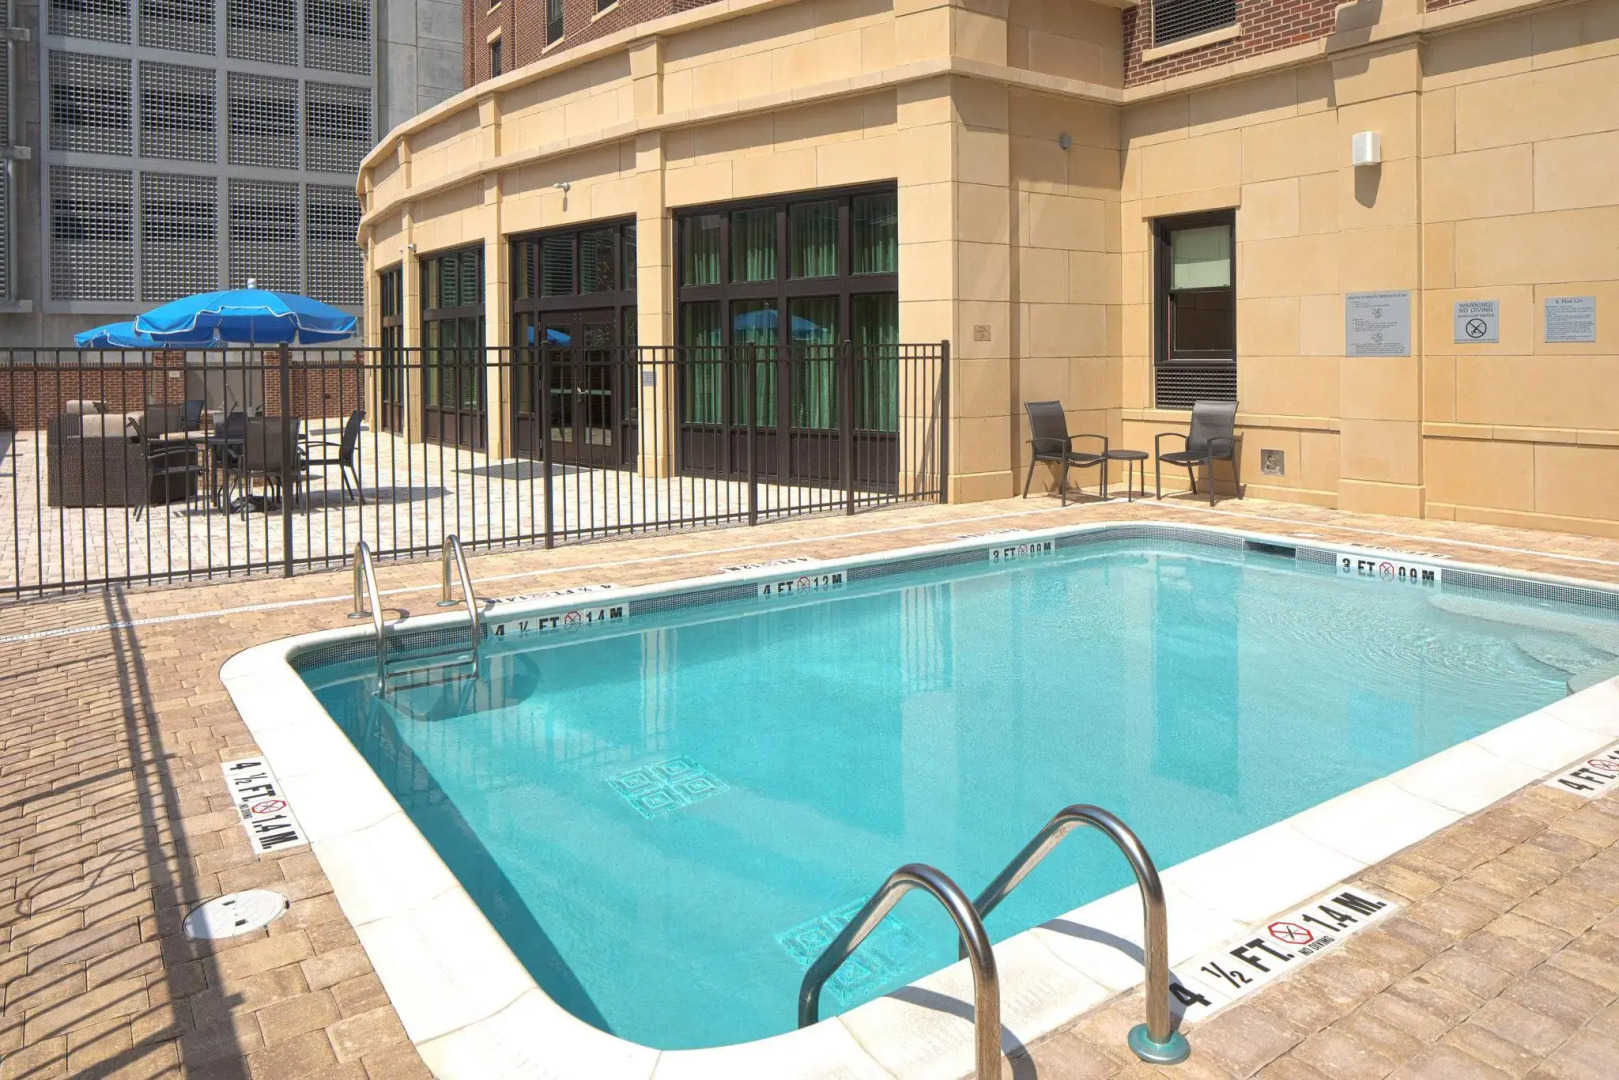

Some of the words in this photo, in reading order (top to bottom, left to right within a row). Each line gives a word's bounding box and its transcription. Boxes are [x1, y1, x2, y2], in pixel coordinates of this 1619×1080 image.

[1298, 945, 1313, 956] NO
[1311, 935, 1336, 952] DIVING
[1169, 983, 1212, 1007] 4
